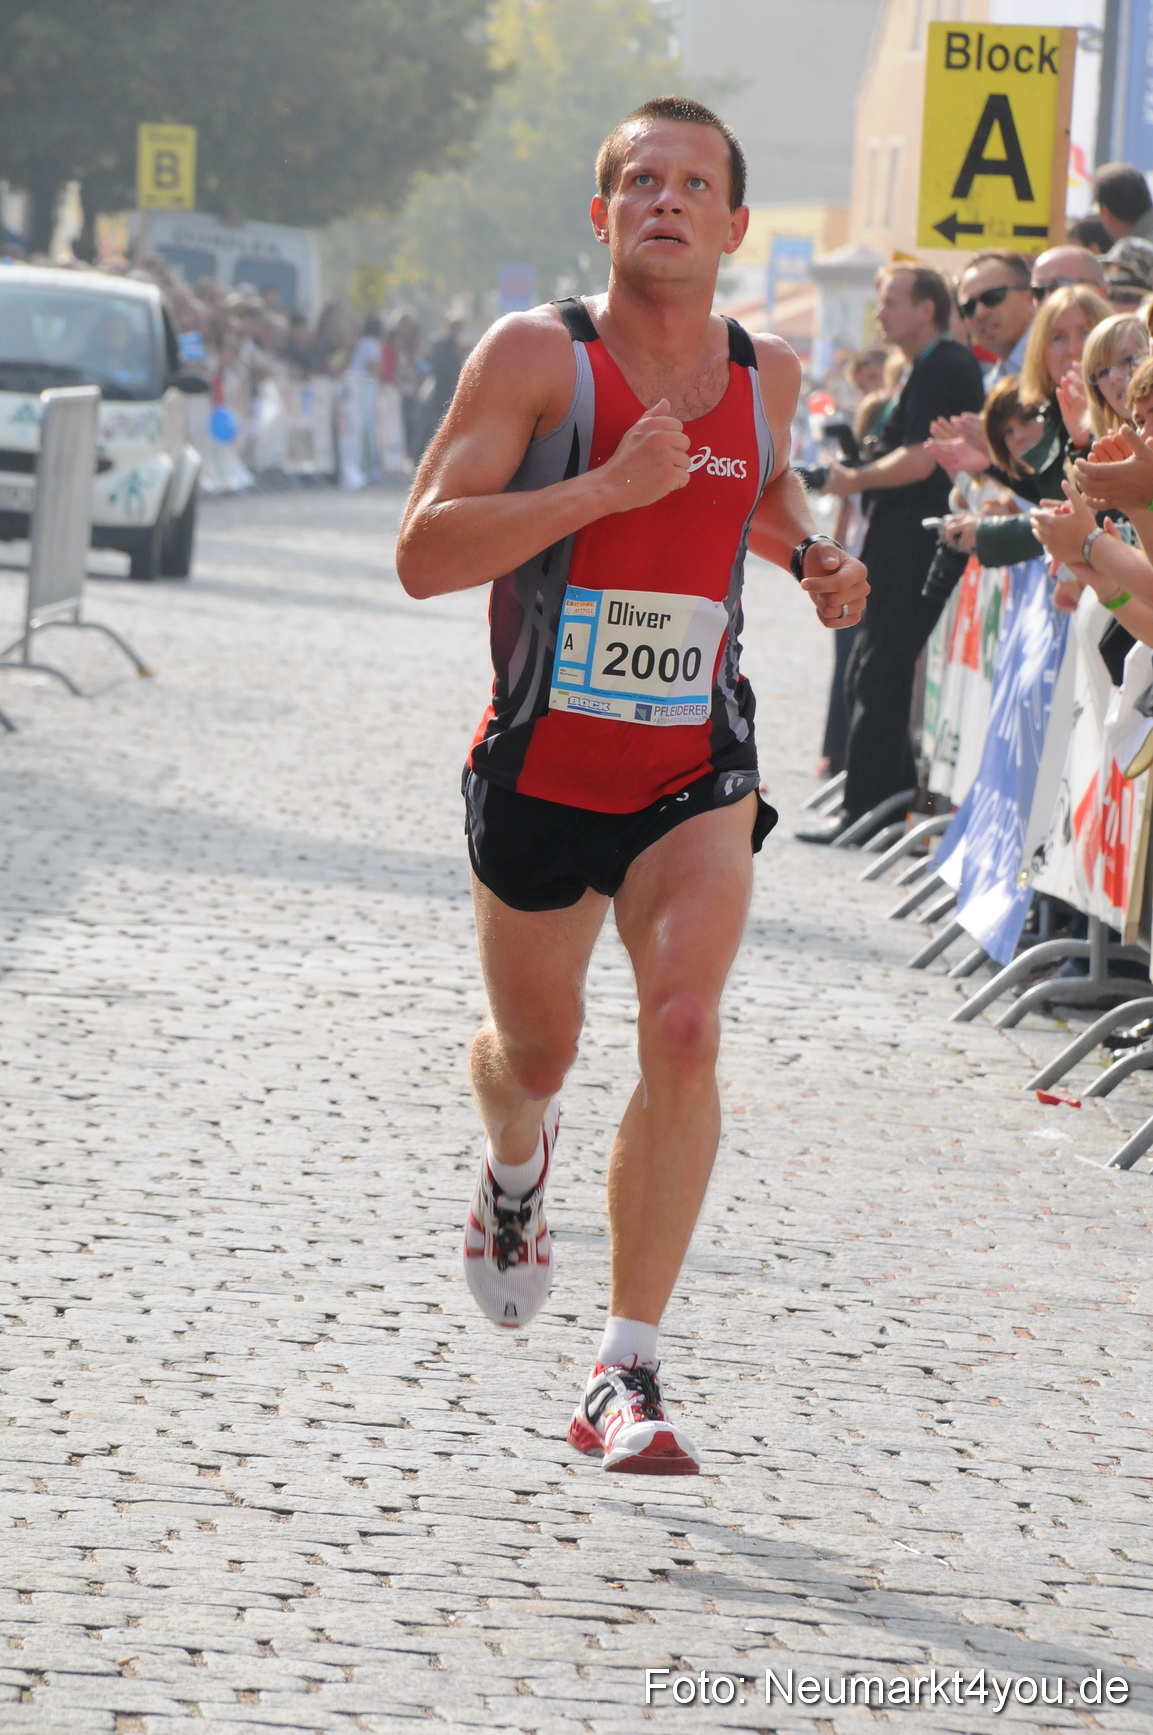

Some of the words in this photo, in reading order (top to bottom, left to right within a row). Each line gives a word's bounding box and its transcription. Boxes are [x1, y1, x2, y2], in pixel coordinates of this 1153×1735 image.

[945, 31, 1060, 75] Block
[951, 93, 1035, 202] A
[153, 150, 181, 190] B
[706, 455, 747, 479] asics
[607, 600, 672, 630] Oliver
[563, 633, 574, 650] A
[601, 641, 702, 683] 2000
[567, 696, 611, 711] BOCK
[653, 704, 708, 717] PFLEIDERER
